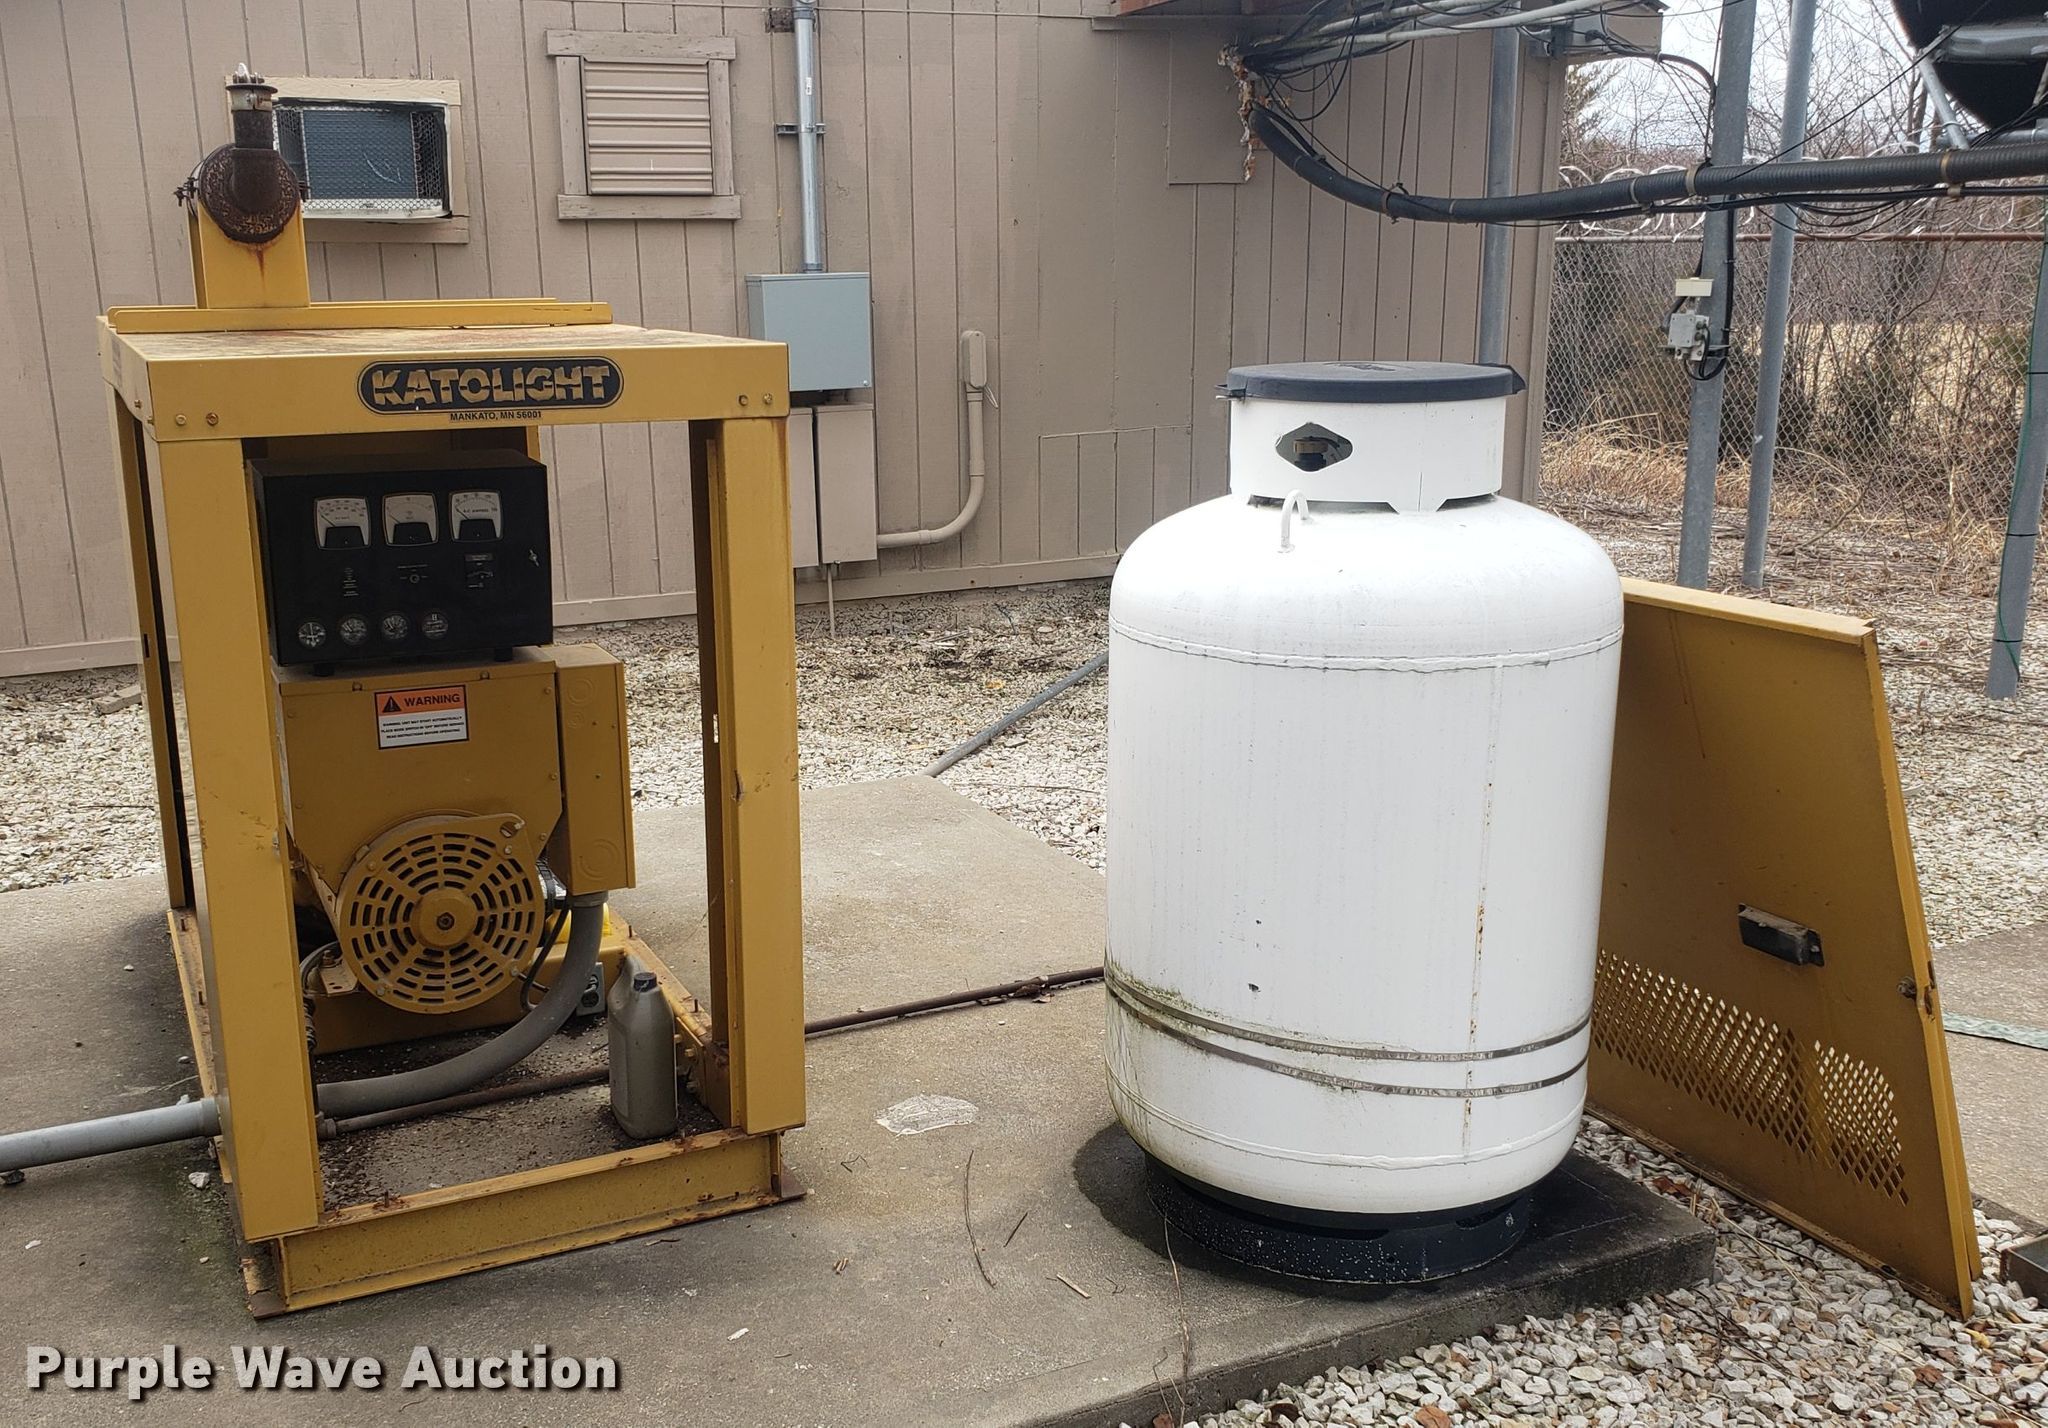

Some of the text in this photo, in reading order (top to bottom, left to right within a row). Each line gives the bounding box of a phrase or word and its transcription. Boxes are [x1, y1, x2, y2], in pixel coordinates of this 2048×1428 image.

[371, 365, 610, 405] KATOLIGHT
[450, 410, 541, 420] MANKATO, MN 56001
[404, 693, 460, 707] WARNING
